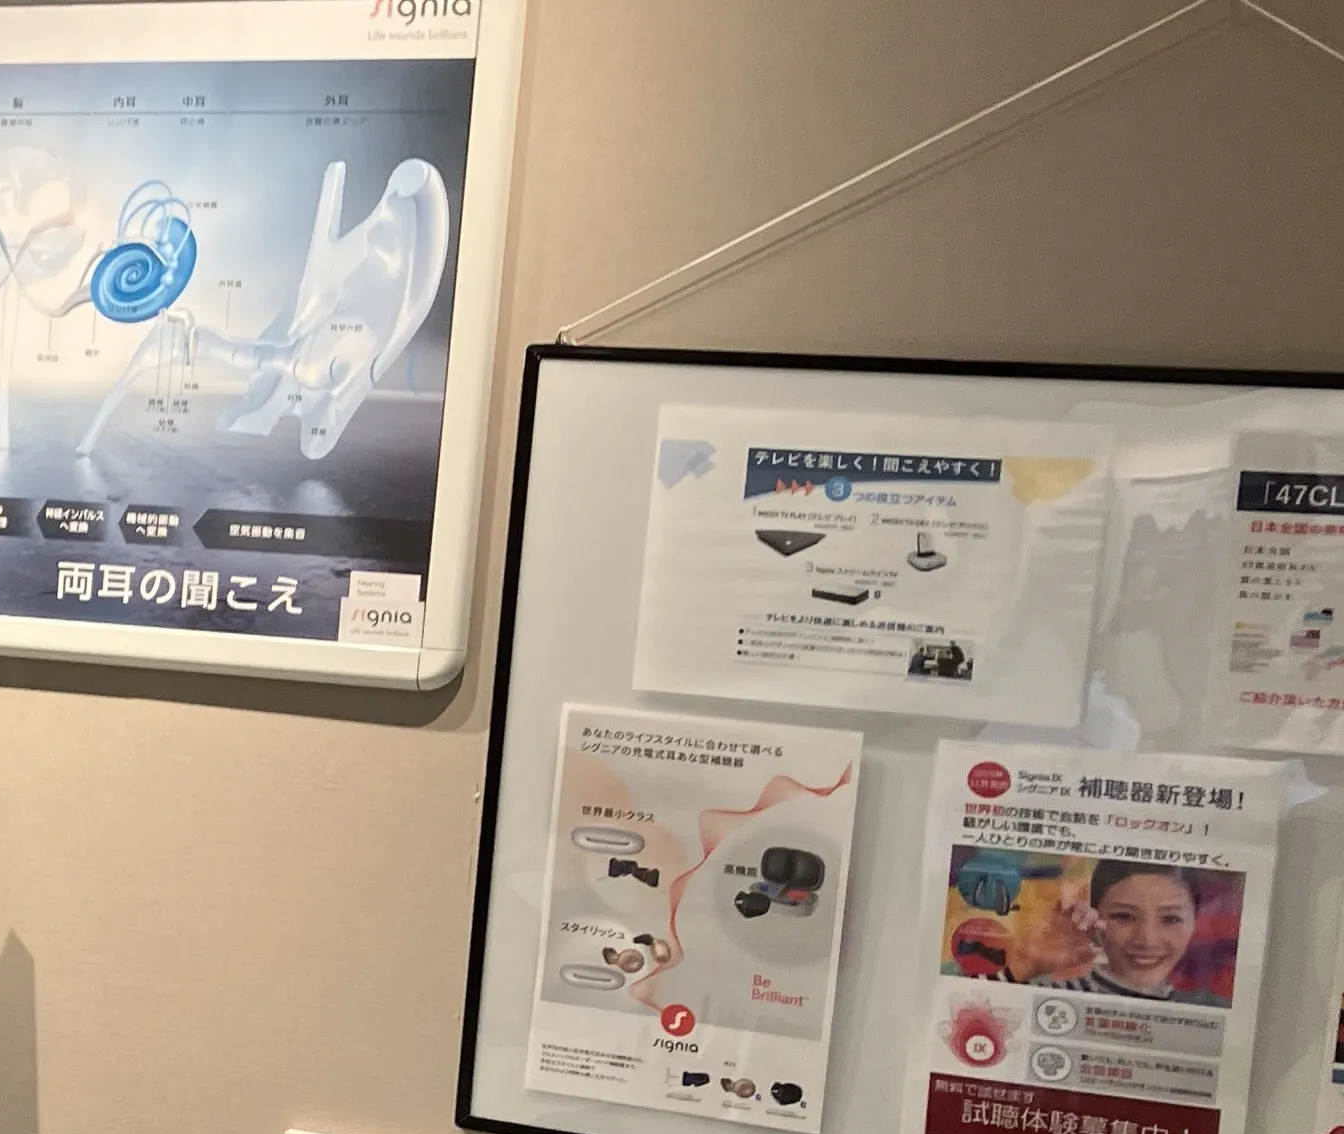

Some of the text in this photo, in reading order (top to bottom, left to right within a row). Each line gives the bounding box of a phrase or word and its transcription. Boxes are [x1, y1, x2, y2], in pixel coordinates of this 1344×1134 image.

[55, 561, 304, 615] 両耳の聞こえ
[351, 605, 412, 628] signia
[560, 920, 626, 941] スタイリッシュ
[752, 974, 772, 989] Be
[652, 1037, 699, 1054] signia
